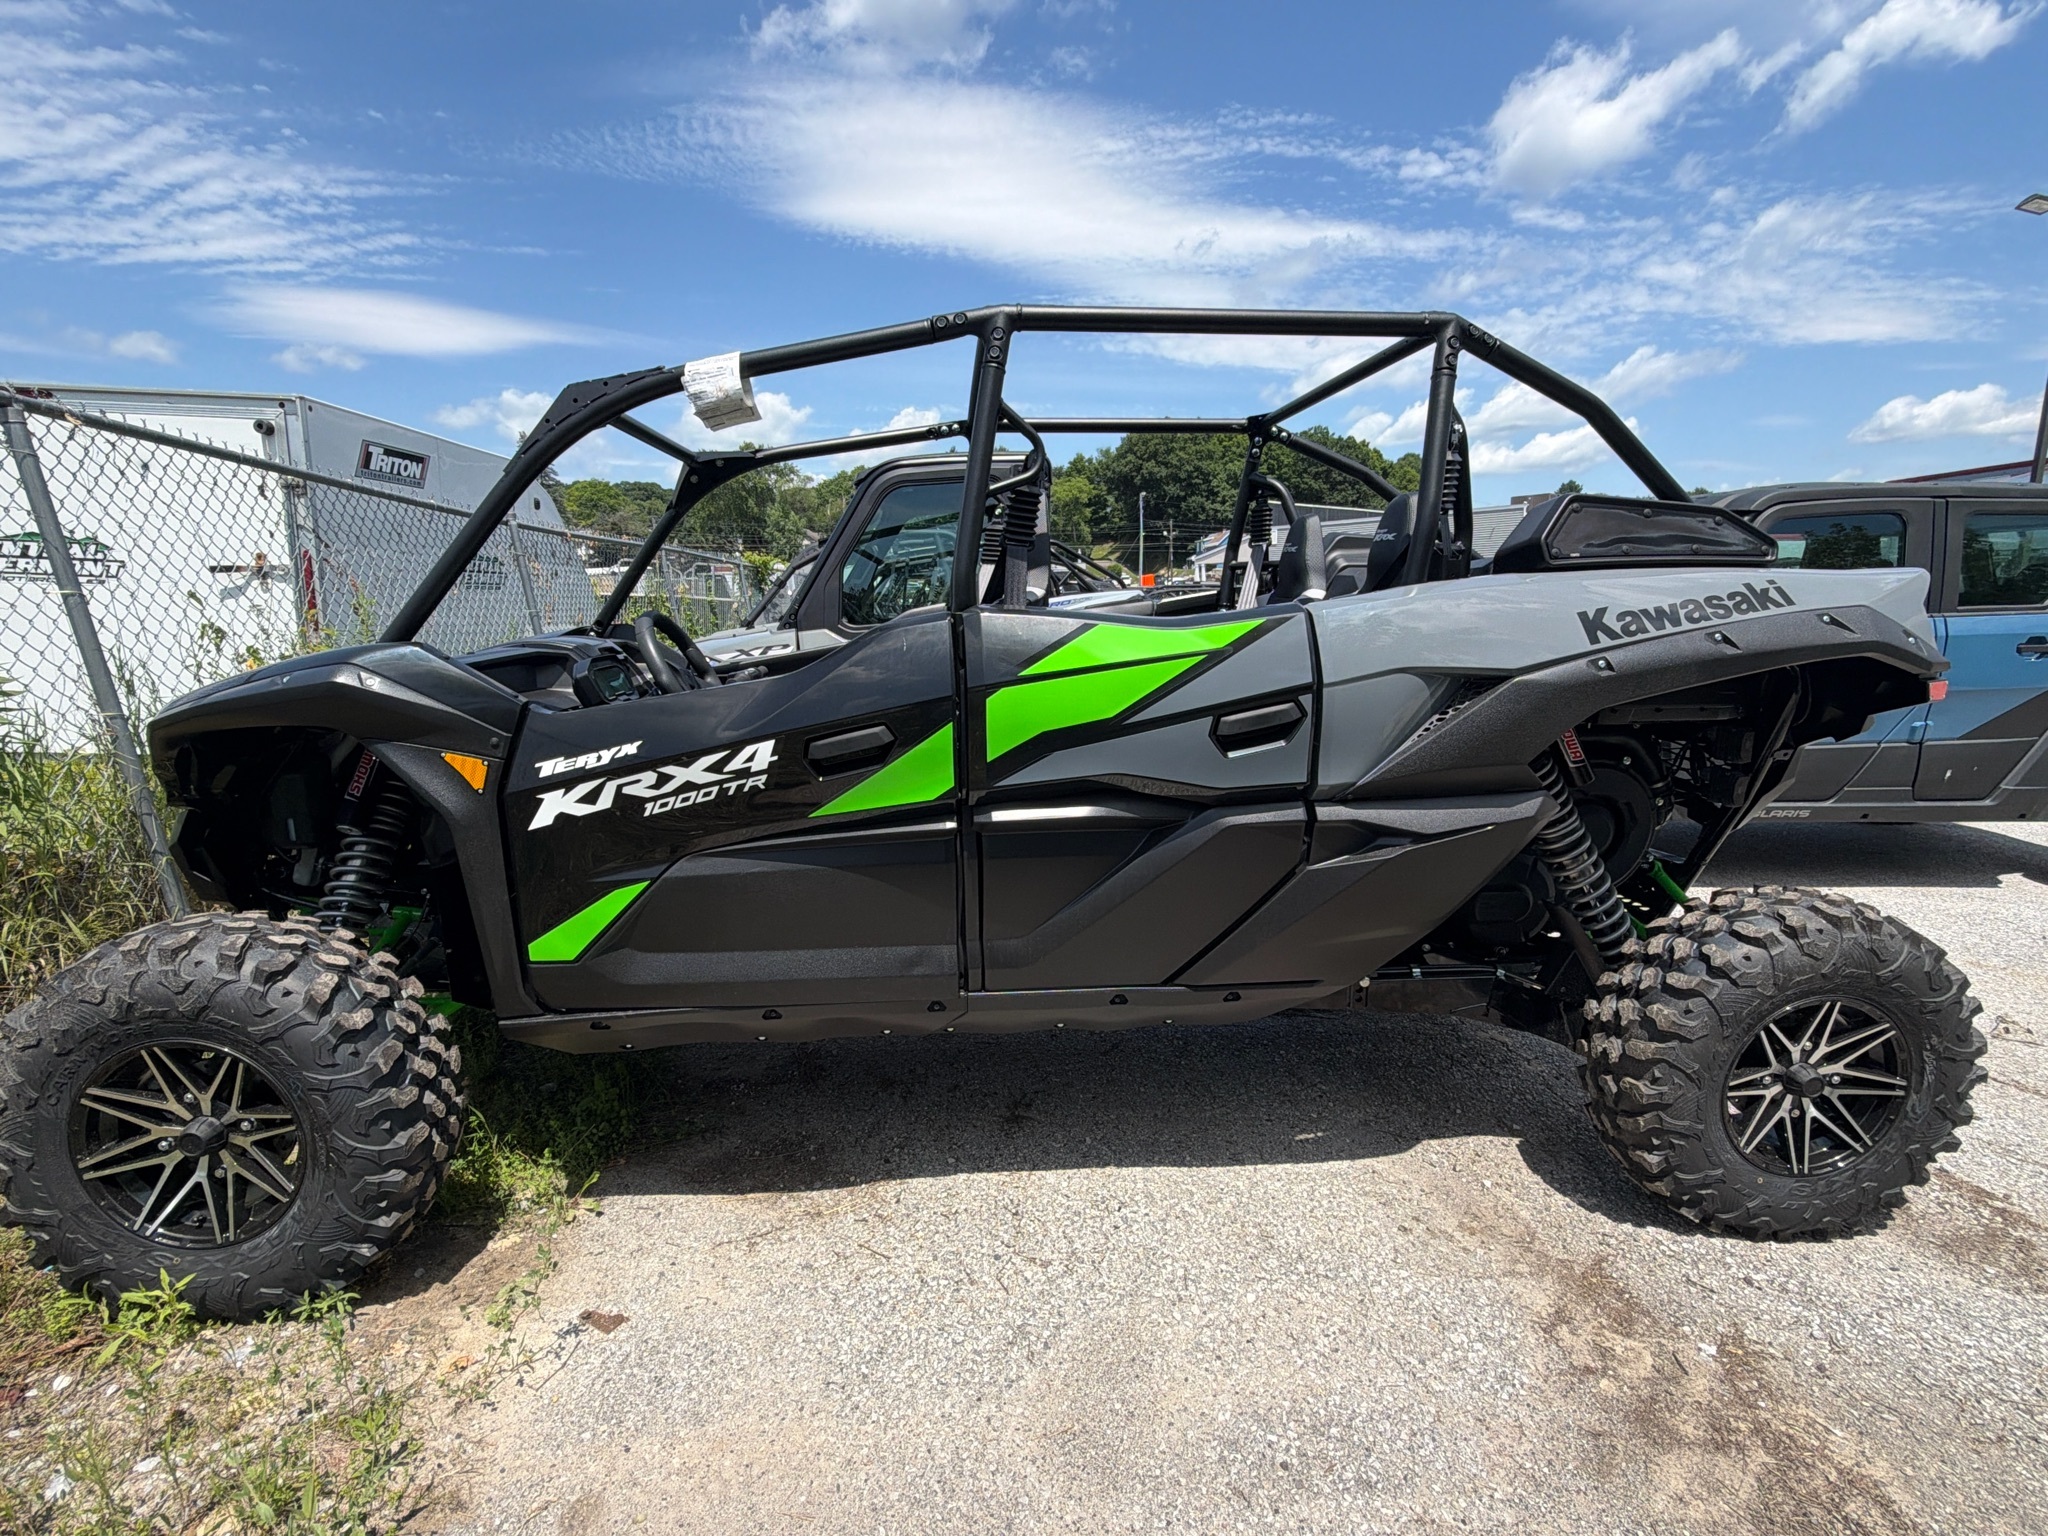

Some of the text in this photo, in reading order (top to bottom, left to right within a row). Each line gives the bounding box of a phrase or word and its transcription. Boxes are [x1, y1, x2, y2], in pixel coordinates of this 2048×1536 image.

[367, 445, 422, 479] TRITON
[360, 469, 422, 487] tritontrailers.com
[0, 541, 106, 559] NTAL
[0, 559, 125, 578] ERMNT
[1576, 579, 1797, 645] Kawasaki
[728, 643, 791, 660] XP
[534, 740, 643, 778] TERYX
